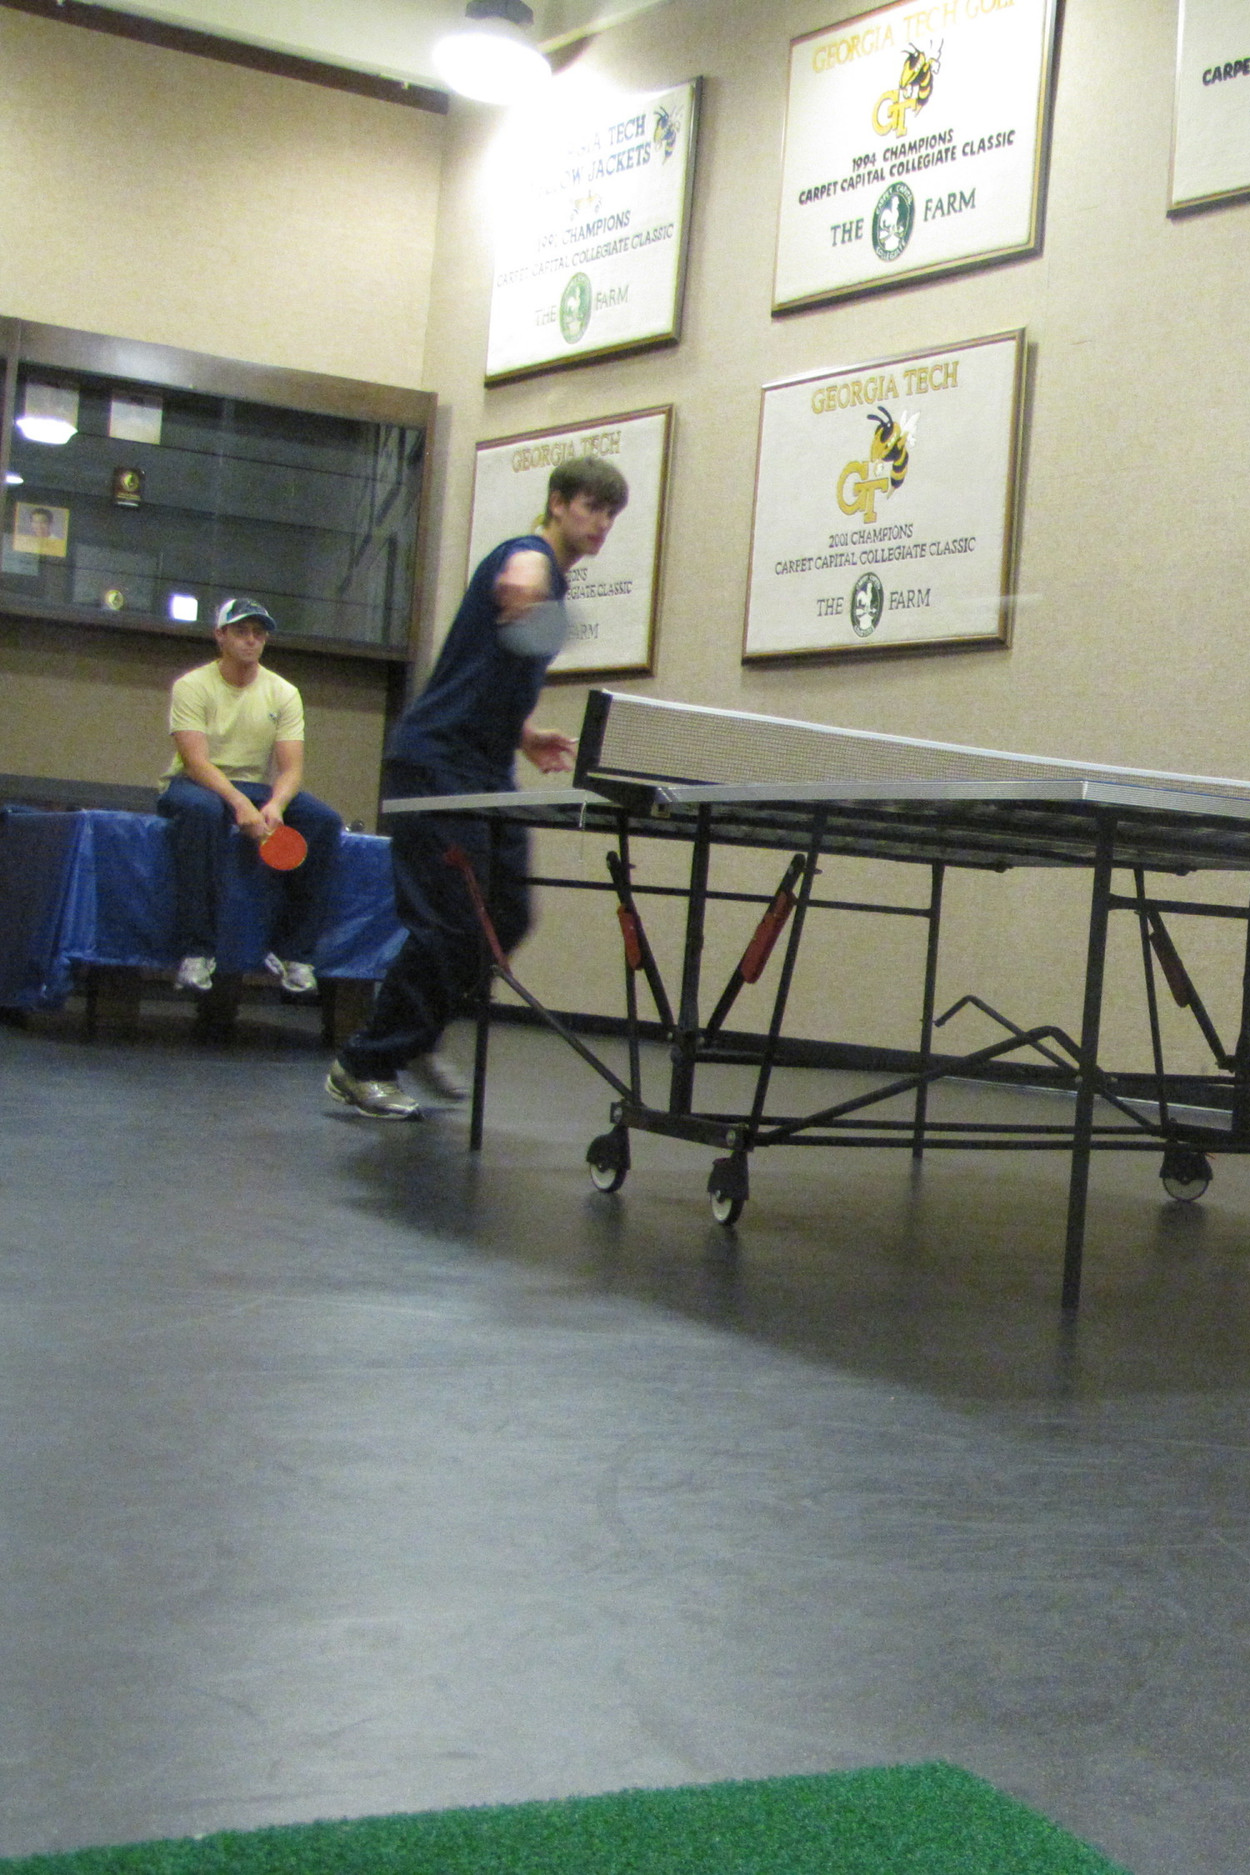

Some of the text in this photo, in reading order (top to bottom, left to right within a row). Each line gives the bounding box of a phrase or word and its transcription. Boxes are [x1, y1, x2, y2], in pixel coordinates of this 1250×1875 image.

[811, 24, 895, 73] GEORGIA
[903, 1, 957, 41] TECH
[607, 113, 647, 148] TECH
[852, 129, 954, 173] 1994 CHAMPIONS
[588, 141, 652, 183] JACKETS
[799, 130, 1016, 205] CARPET CAPITAL COLLEGIATE CLASSIC
[562, 210, 631, 246] CHAMPIONS
[830, 188, 976, 247] THE FARM
[571, 236, 629, 266] COLLEGIATE
[631, 223, 674, 249] CLASSIC
[535, 284, 630, 327] THE FARM
[811, 361, 959, 414] GEORGIA TECH
[512, 440, 575, 473] GEORGIA
[775, 537, 976, 575] CARPET CAPITAL COLLEGIATE CLASSIC
[828, 523, 913, 548] 2001 CHAMPIONS
[816, 588, 931, 617] THE FARM
